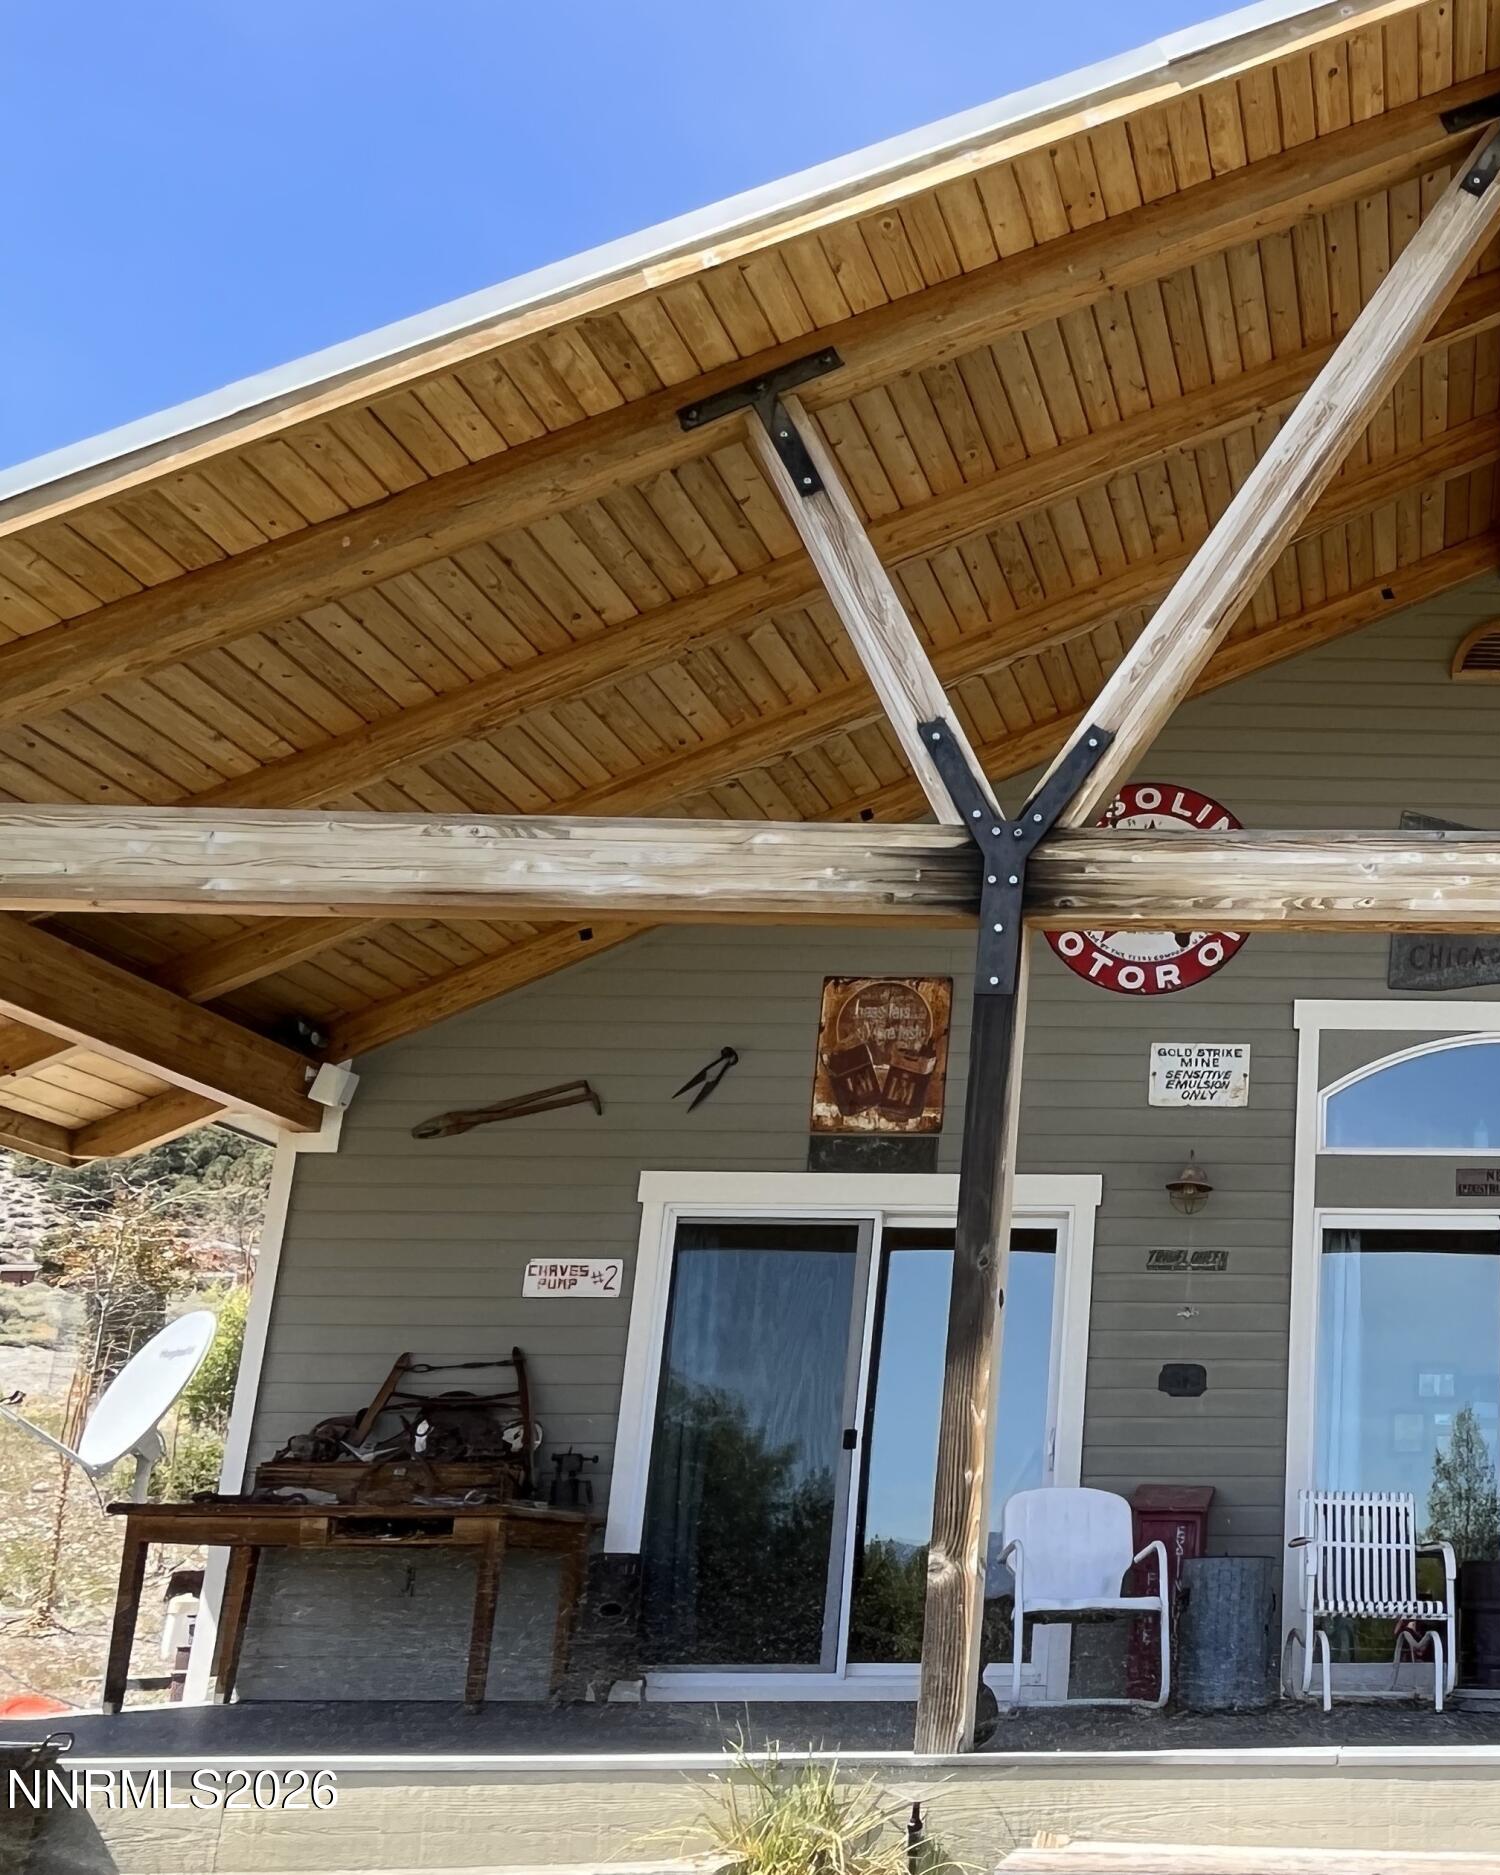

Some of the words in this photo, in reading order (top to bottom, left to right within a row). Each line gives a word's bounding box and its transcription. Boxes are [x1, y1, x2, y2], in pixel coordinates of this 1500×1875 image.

[1058, 931, 1182, 989] OTOR
[1158, 1048, 1192, 1057] GOLD
[1197, 1048, 1243, 1058] STRIKE
[1180, 1058, 1219, 1067] MINE
[1165, 1070, 1232, 1080] SENSITIVE
[1165, 1080, 1230, 1089] EMULSION
[1181, 1090, 1218, 1100] ONLY
[528, 1264, 589, 1277] CHAVES
[537, 1278, 578, 1290] PUMP
[591, 1265, 618, 1290] #2
